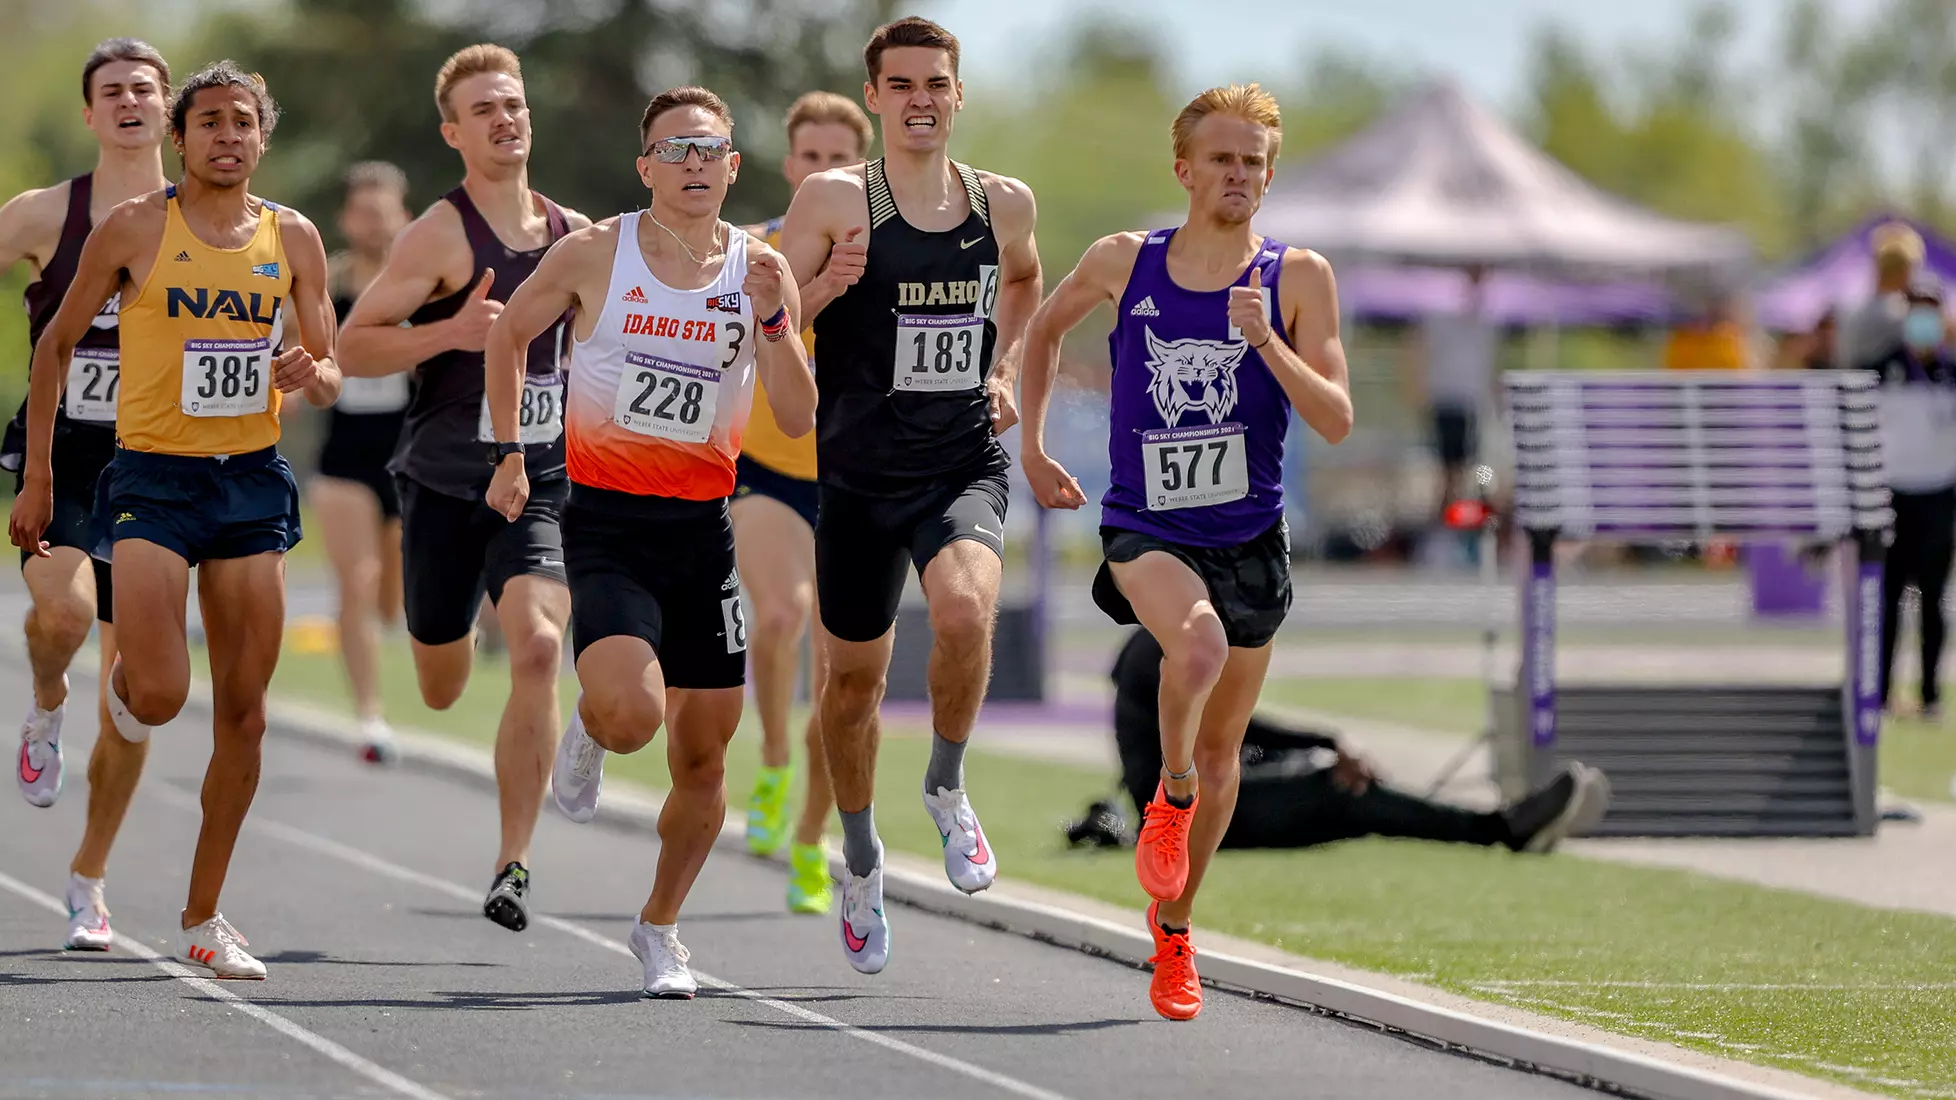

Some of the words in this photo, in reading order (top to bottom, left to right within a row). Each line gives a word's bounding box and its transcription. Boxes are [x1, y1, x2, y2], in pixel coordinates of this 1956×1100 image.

[166, 288, 282, 325] NAU
[622, 296, 648, 304] adidas
[718, 293, 739, 308] SKY
[898, 280, 980, 306] IDAHO
[983, 269, 997, 316] 6
[622, 313, 680, 338] IDAHO
[1130, 308, 1160, 317] adidas
[722, 322, 746, 368] 3
[912, 330, 972, 373] 183
[82, 362, 120, 402] 27
[197, 355, 260, 398] 385
[633, 355, 644, 363] BIG
[644, 357, 656, 365] SKY
[656, 360, 702, 376] CHAMPIONSHIPS
[702, 370, 714, 378] 2021
[629, 371, 704, 424] 228
[633, 420, 651, 428] WEBER
[652, 424, 668, 432] STATE
[1160, 432, 1170, 440] SKY
[1172, 428, 1220, 439] CHAMPIONSHIPS
[1220, 426, 1234, 434] 2021
[1159, 440, 1228, 490] 577
